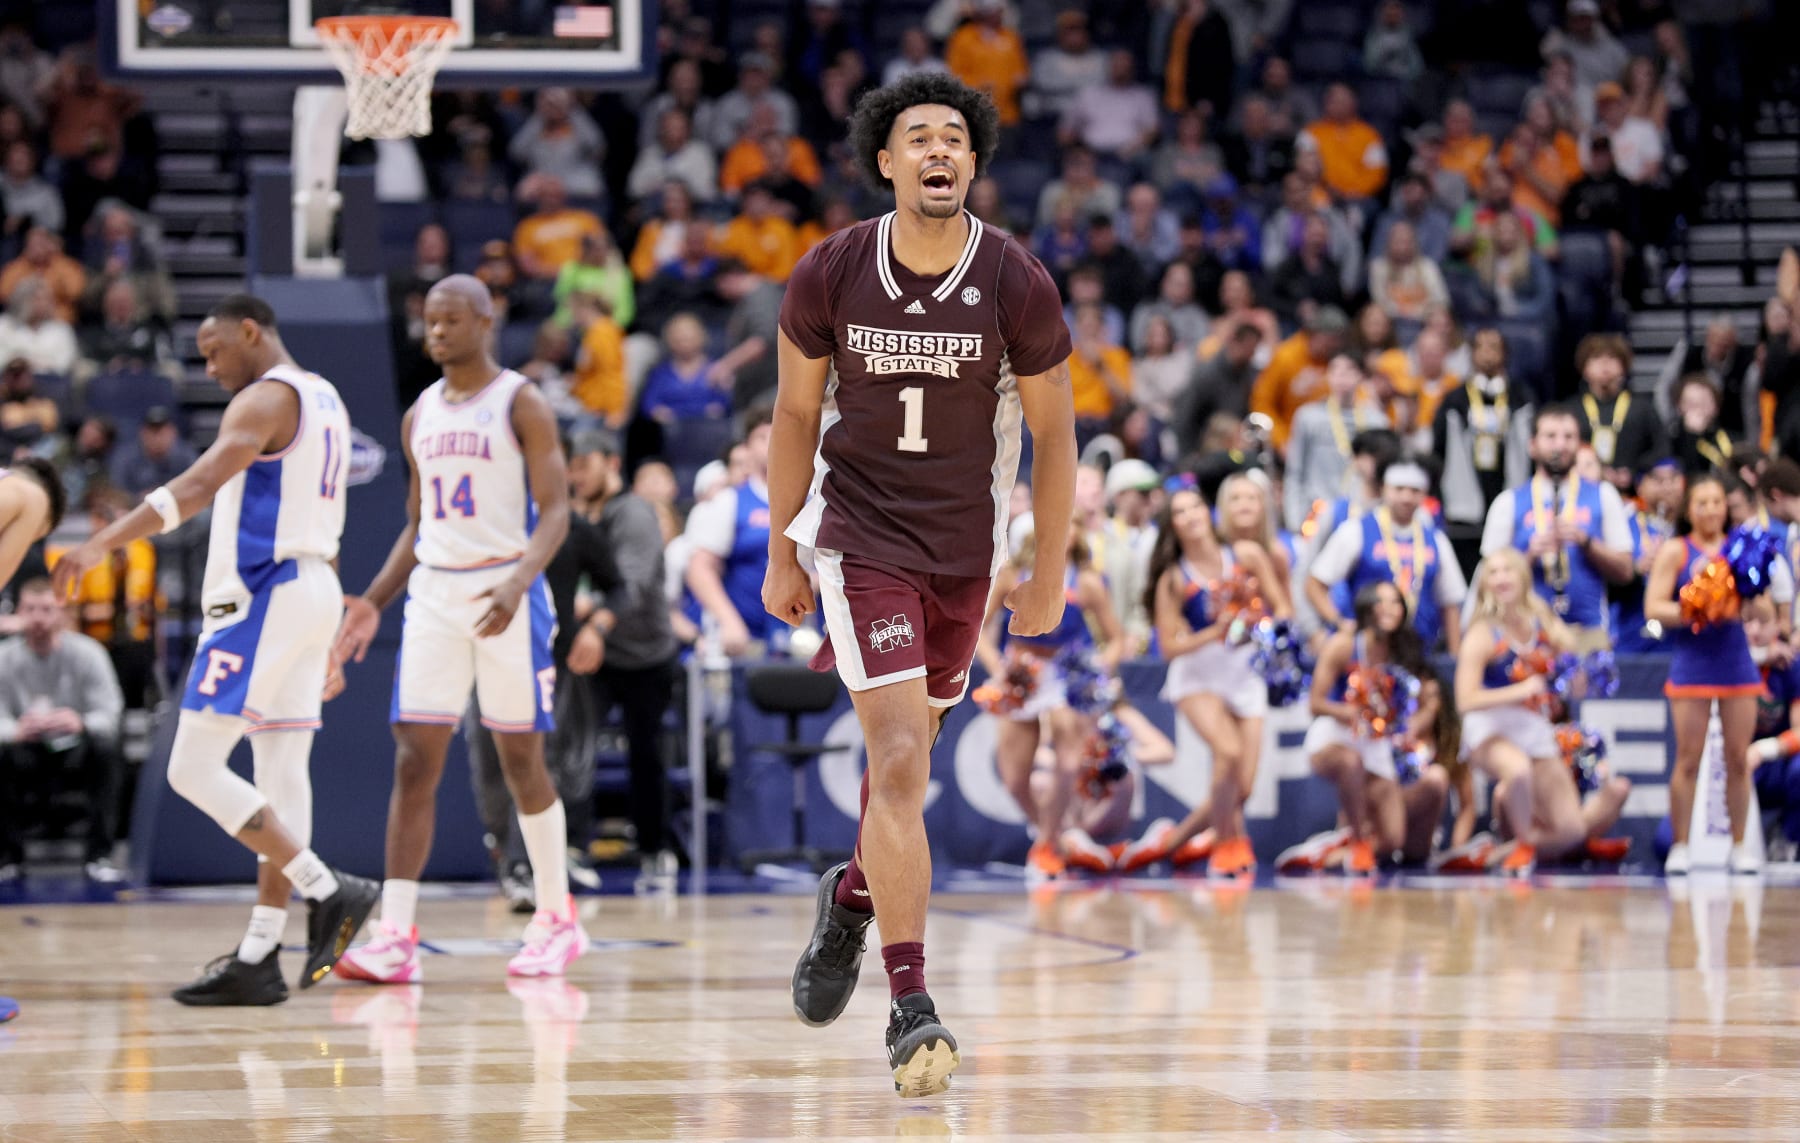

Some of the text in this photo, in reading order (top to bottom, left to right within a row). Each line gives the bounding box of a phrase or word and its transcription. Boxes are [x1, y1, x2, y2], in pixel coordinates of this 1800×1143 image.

[962, 287, 980, 305] SEC
[847, 328, 983, 357] MISSISSIPPI
[881, 358, 942, 374] STATE
[897, 387, 928, 452] 1
[432, 474, 476, 520] 14
[878, 626, 907, 641] STATE
[198, 648, 244, 696] F
